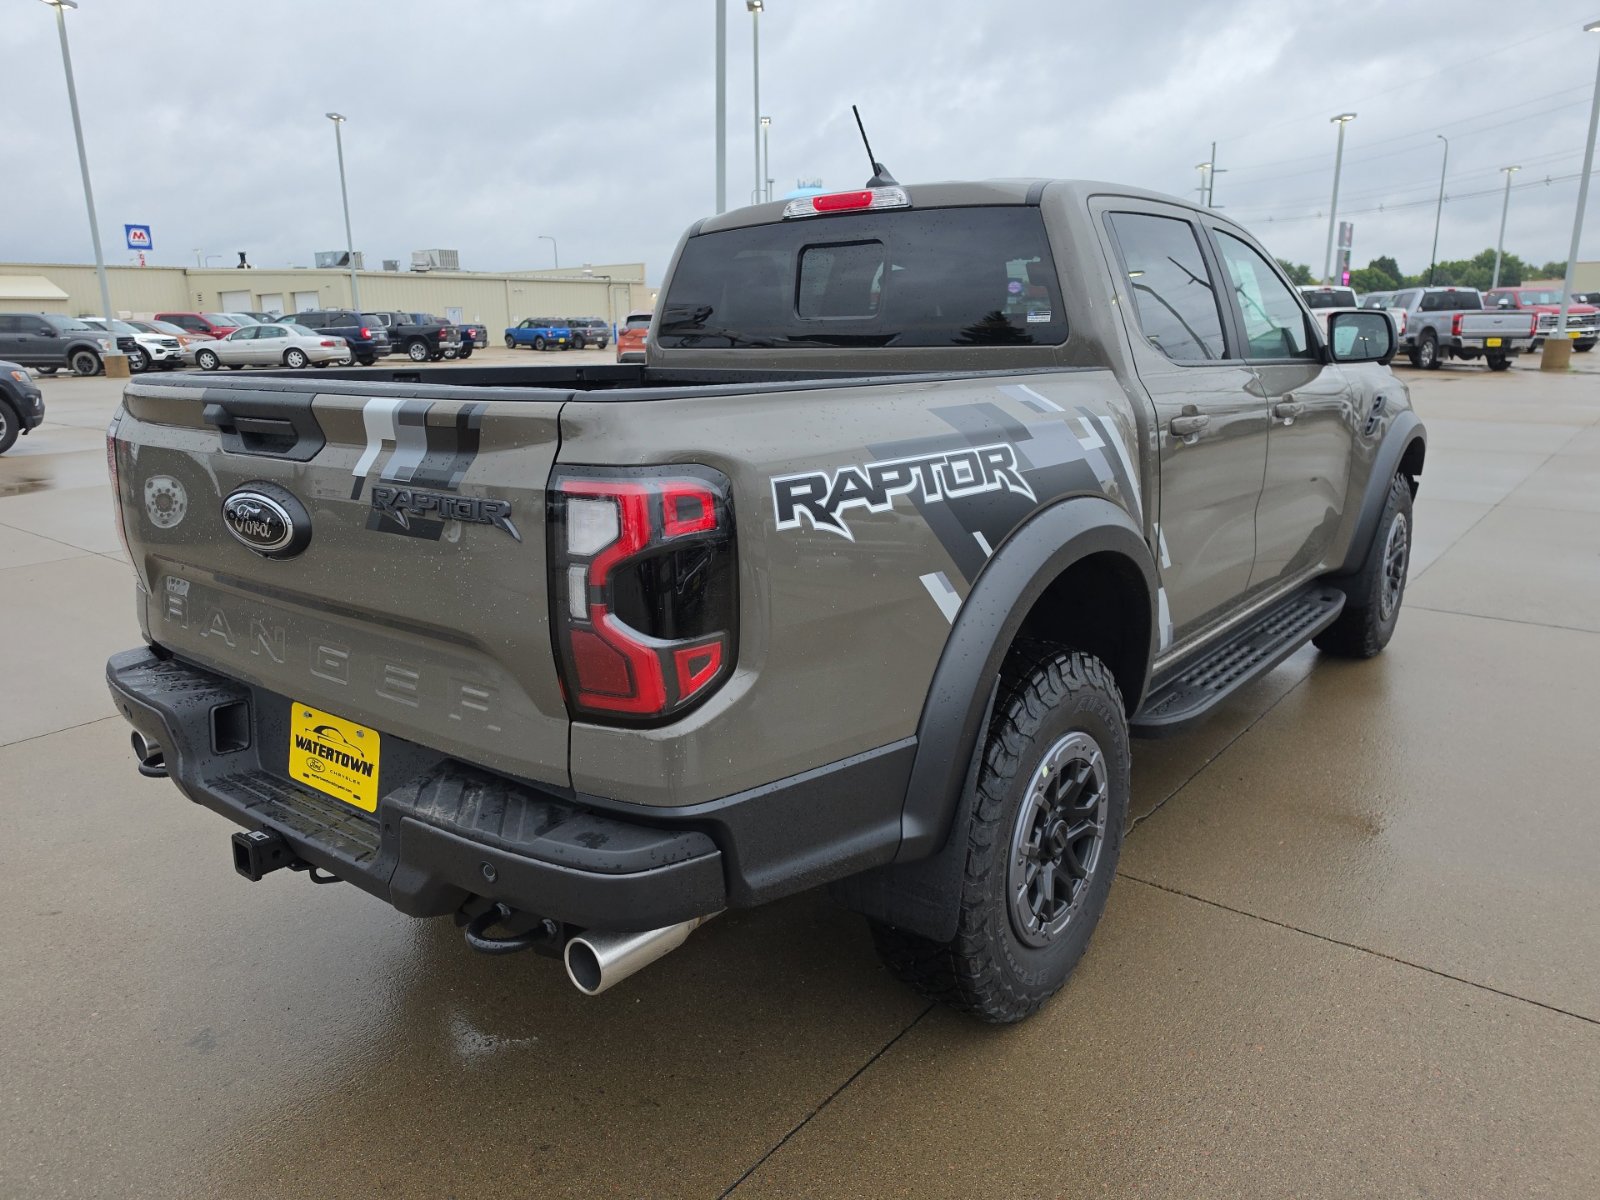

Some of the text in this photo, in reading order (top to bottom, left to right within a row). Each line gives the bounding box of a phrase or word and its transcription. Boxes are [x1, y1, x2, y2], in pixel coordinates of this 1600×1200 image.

[769, 442, 1038, 542] RAPTOR
[235, 503, 272, 538] Ford
[371, 486, 523, 544] RAPTOR
[162, 590, 502, 733] RANGER
[295, 734, 373, 778] WATERTOWN
[309, 758, 322, 771] Ford
[329, 769, 361, 786] CHRYSLER
